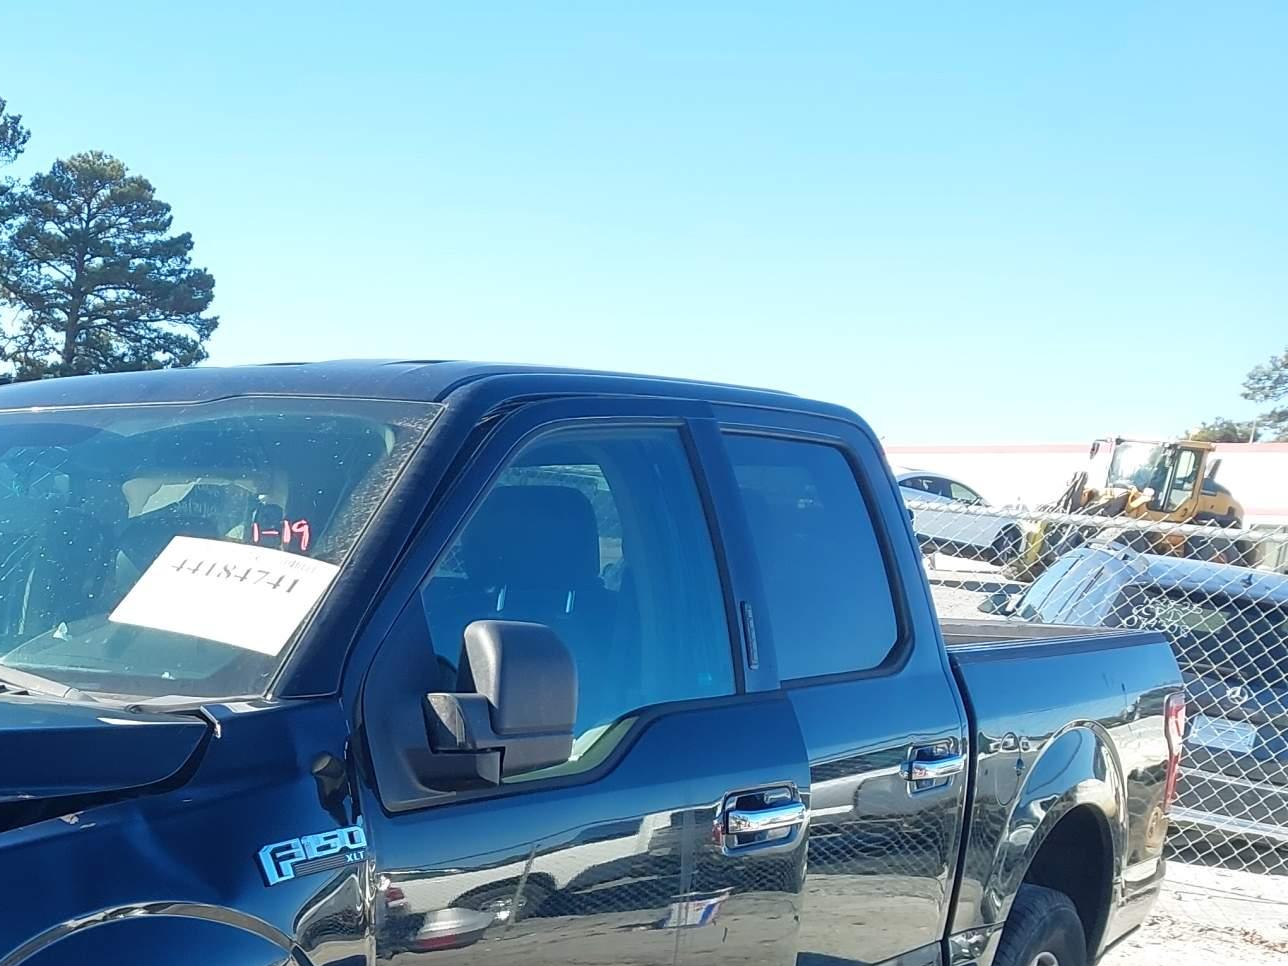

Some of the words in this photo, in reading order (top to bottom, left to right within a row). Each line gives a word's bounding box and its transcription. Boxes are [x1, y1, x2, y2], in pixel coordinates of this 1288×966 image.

[251, 519, 310, 551] 1-19
[171, 558, 300, 593] 44184741
[345, 850, 365, 863] XLT
